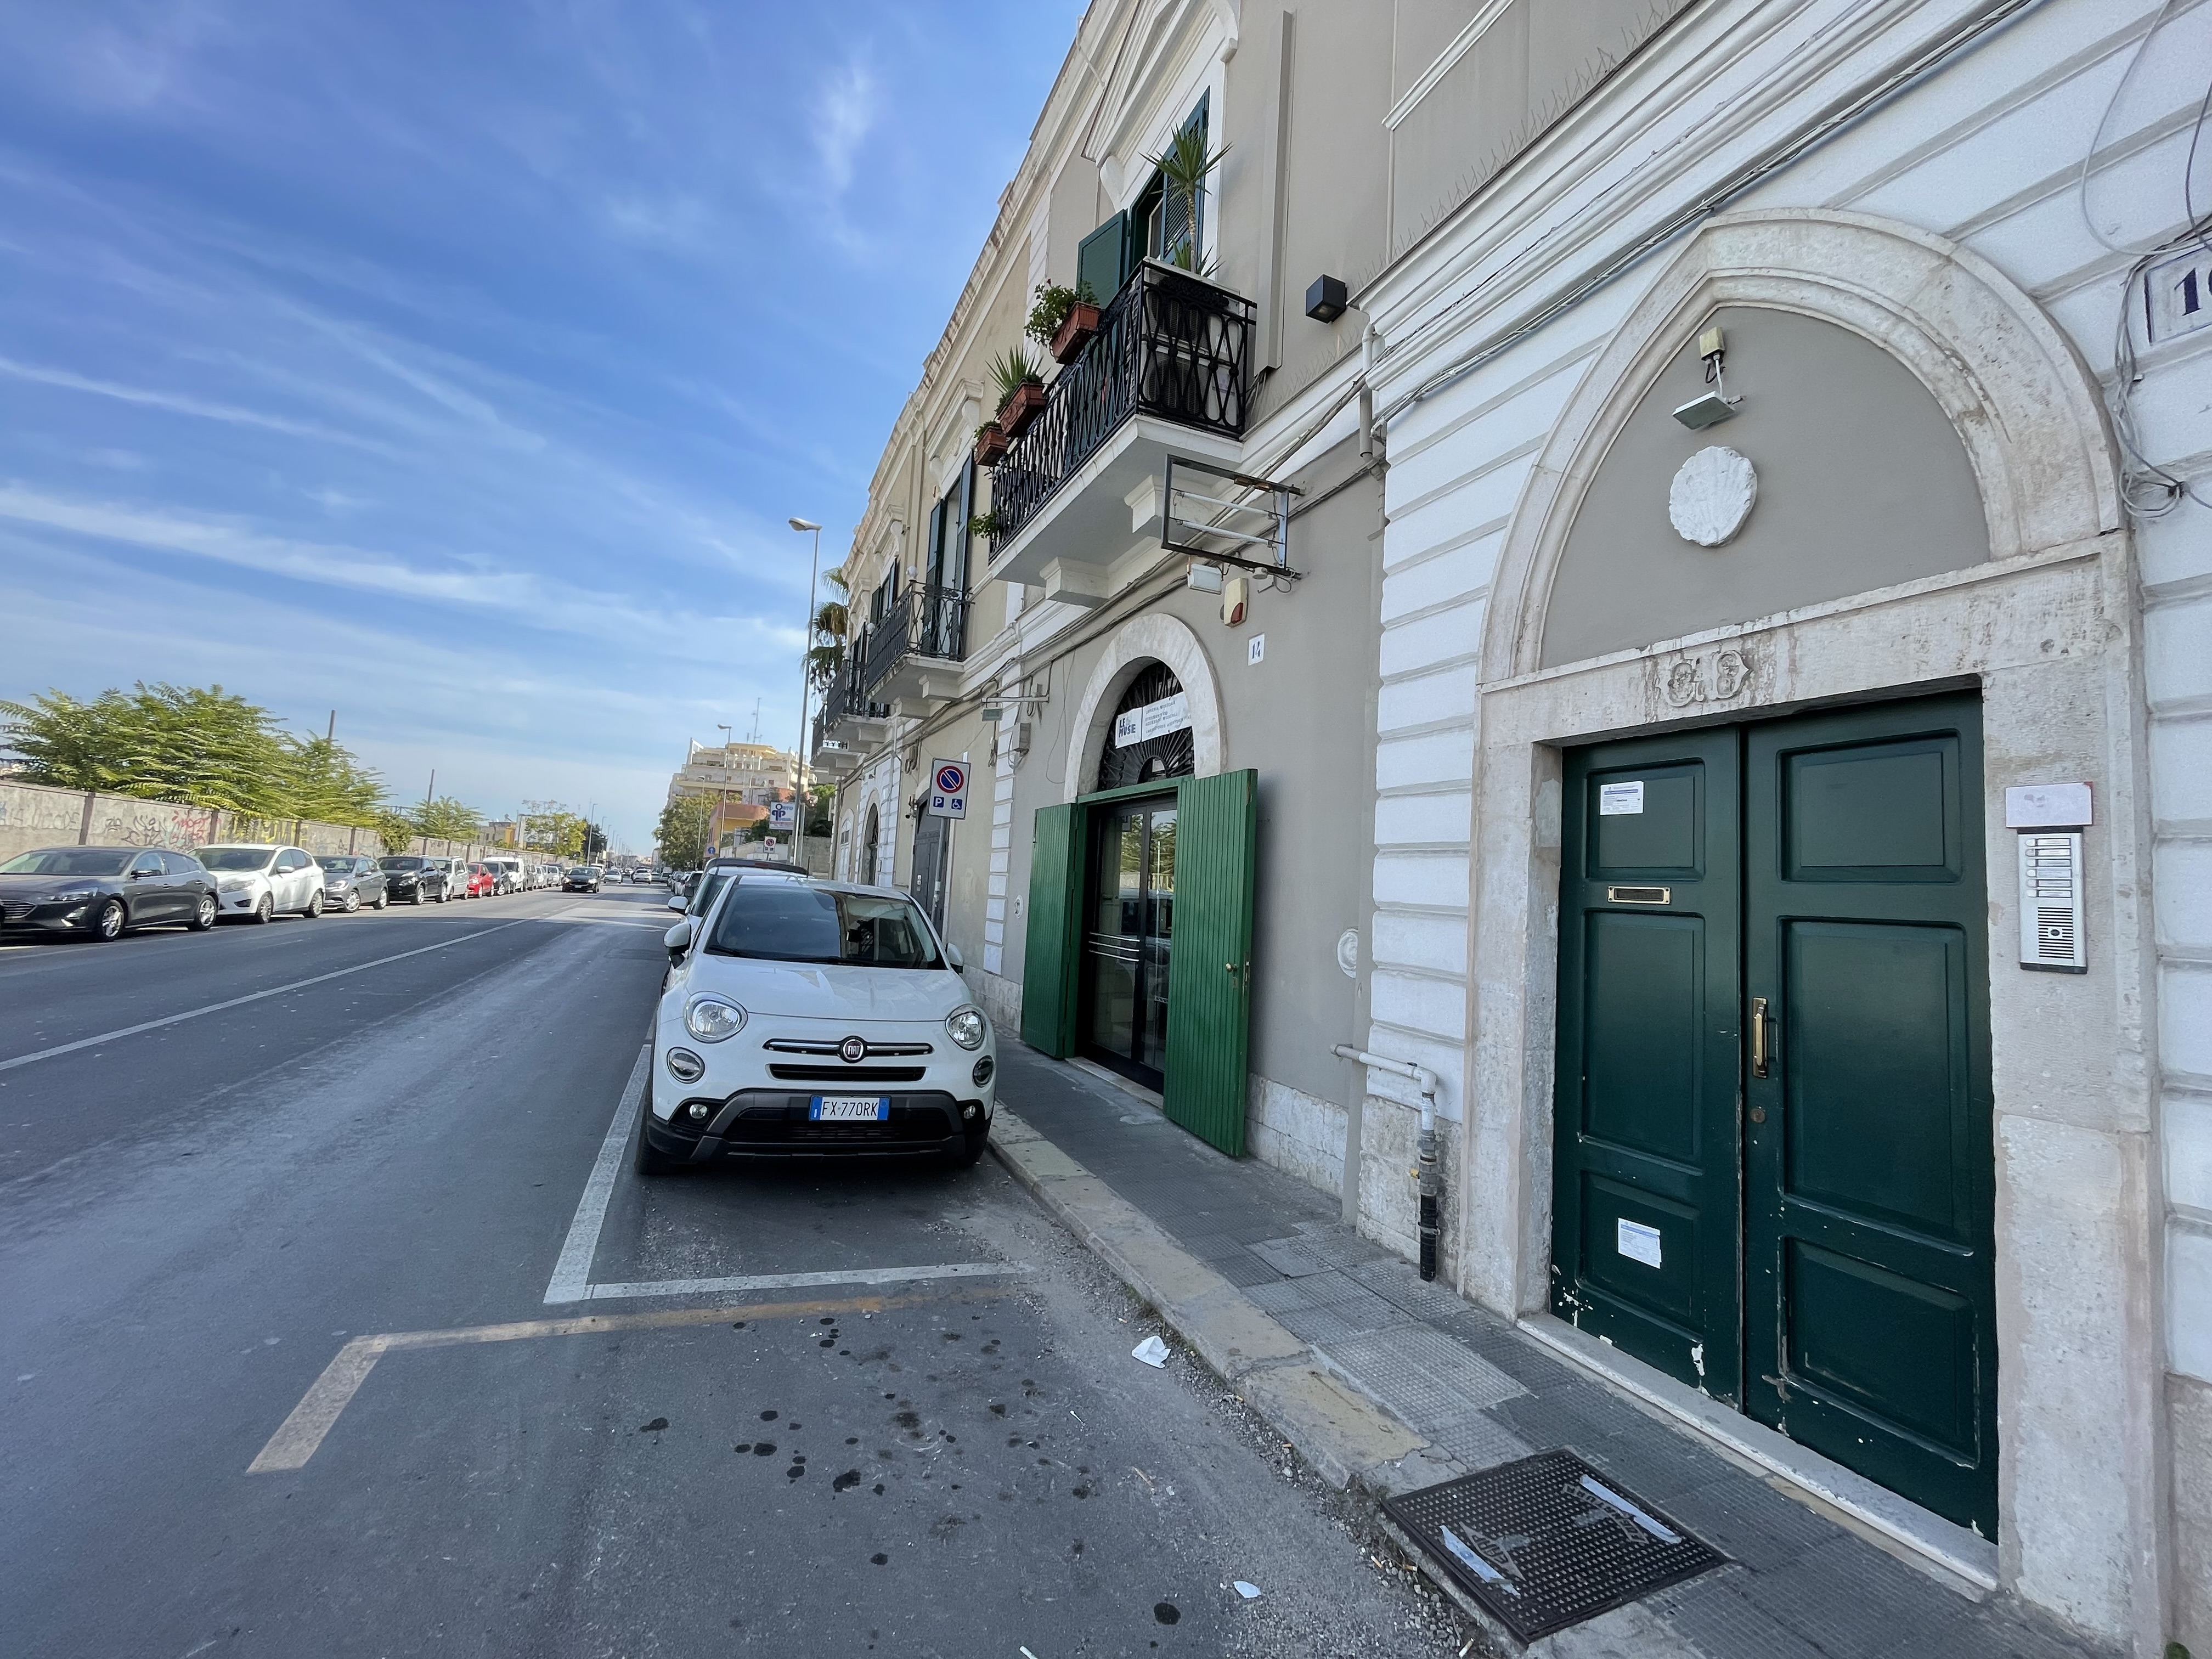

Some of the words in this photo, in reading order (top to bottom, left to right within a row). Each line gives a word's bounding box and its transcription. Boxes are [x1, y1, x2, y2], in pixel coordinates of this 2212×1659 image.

[2174, 268, 2212, 317] 1
[1252, 641, 1261, 659] 14
[1120, 718, 1125, 729] LE
[1119, 724, 1136, 738] MUSE
[935, 798, 942, 806] P
[848, 1045, 860, 1055] FIAT
[1471, 1535, 1509, 1564] EAAP
